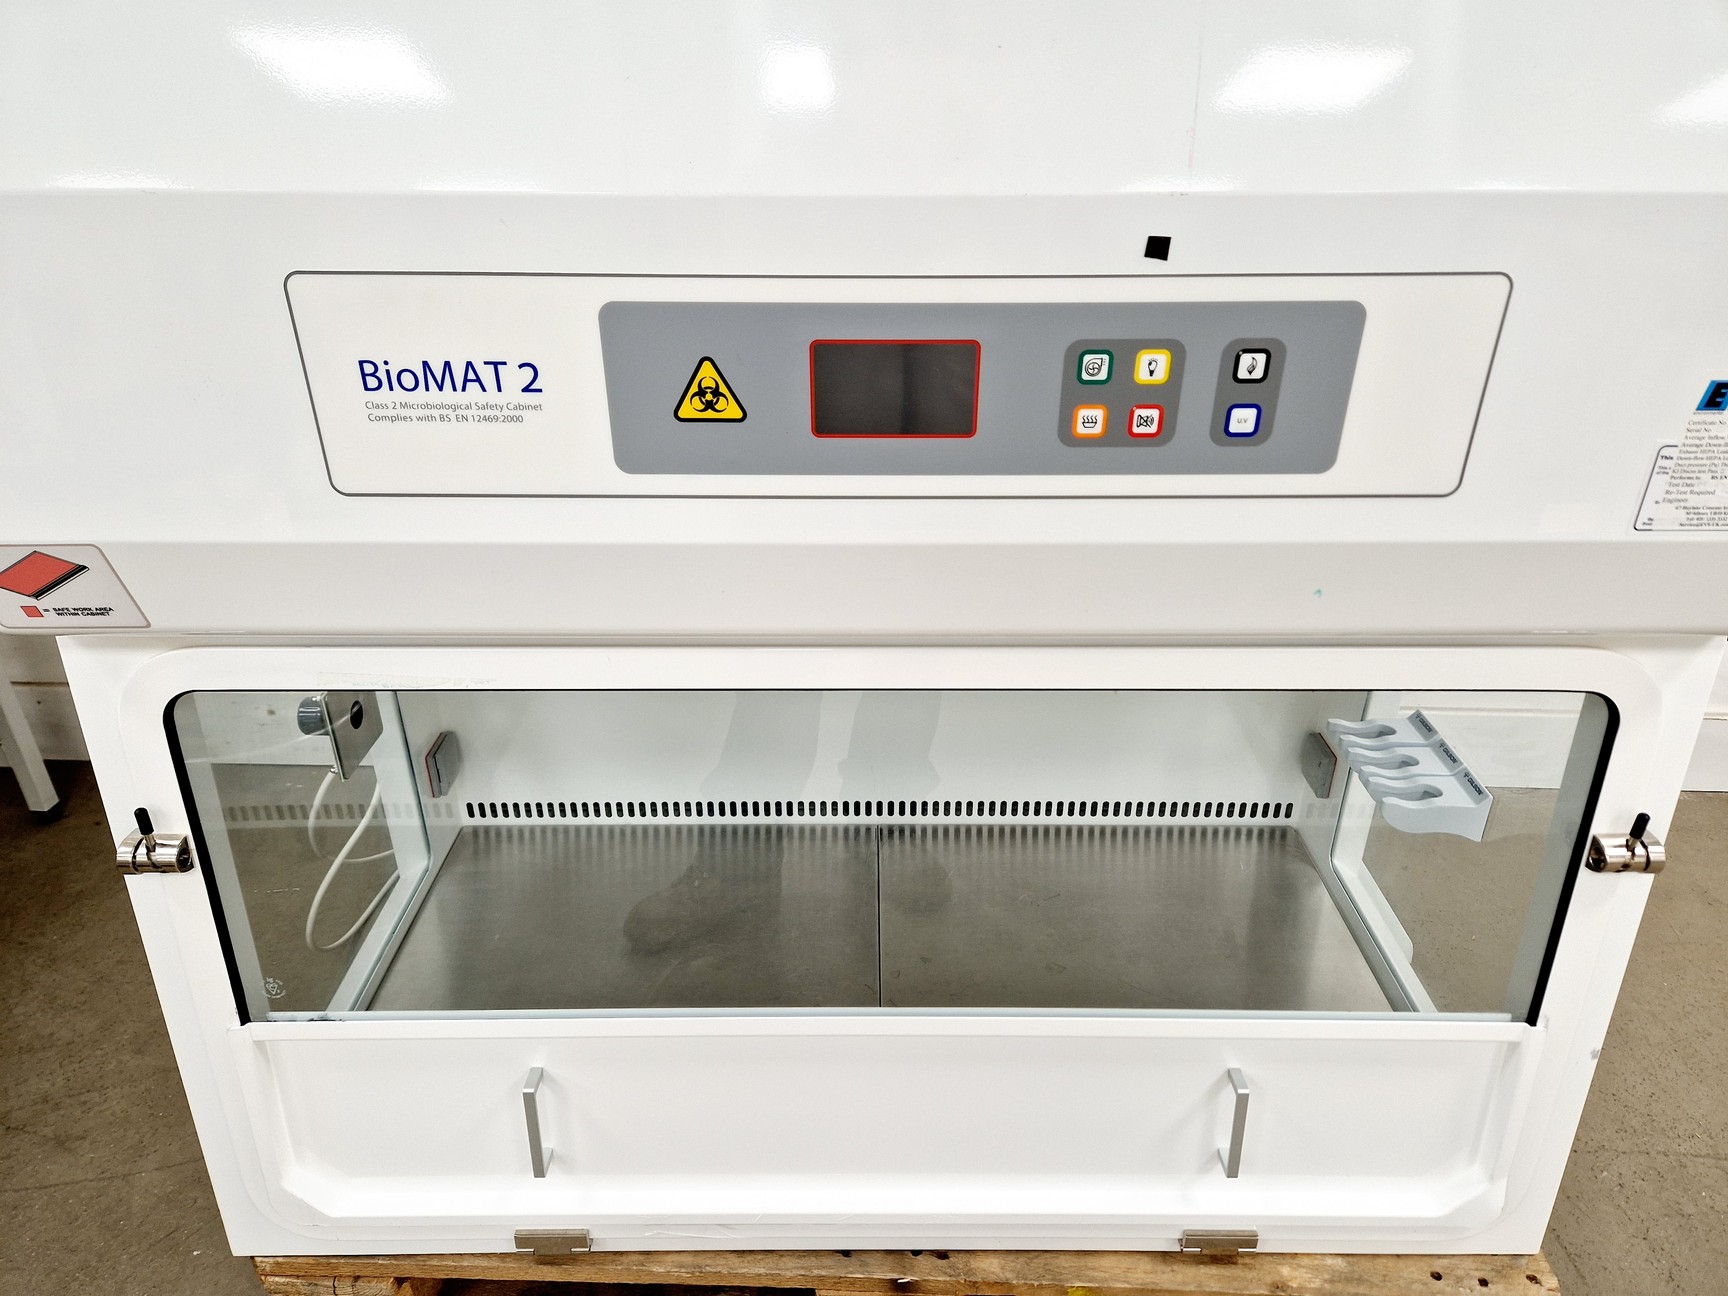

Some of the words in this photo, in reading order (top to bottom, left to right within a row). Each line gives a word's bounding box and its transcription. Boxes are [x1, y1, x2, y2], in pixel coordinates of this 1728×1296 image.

[358, 360, 508, 392] BioMAT
[517, 362, 543, 393] 2
[365, 401, 389, 410] Class
[391, 401, 398, 410] 2
[400, 401, 473, 413] Microbiological
[475, 402, 504, 413] Safety
[506, 402, 543, 411] Cabinet
[367, 413, 413, 424] Complies
[416, 414, 437, 422] with
[439, 414, 451, 423] BS
[455, 415, 469, 423] EN
[471, 414, 524, 423] 12469:2000
